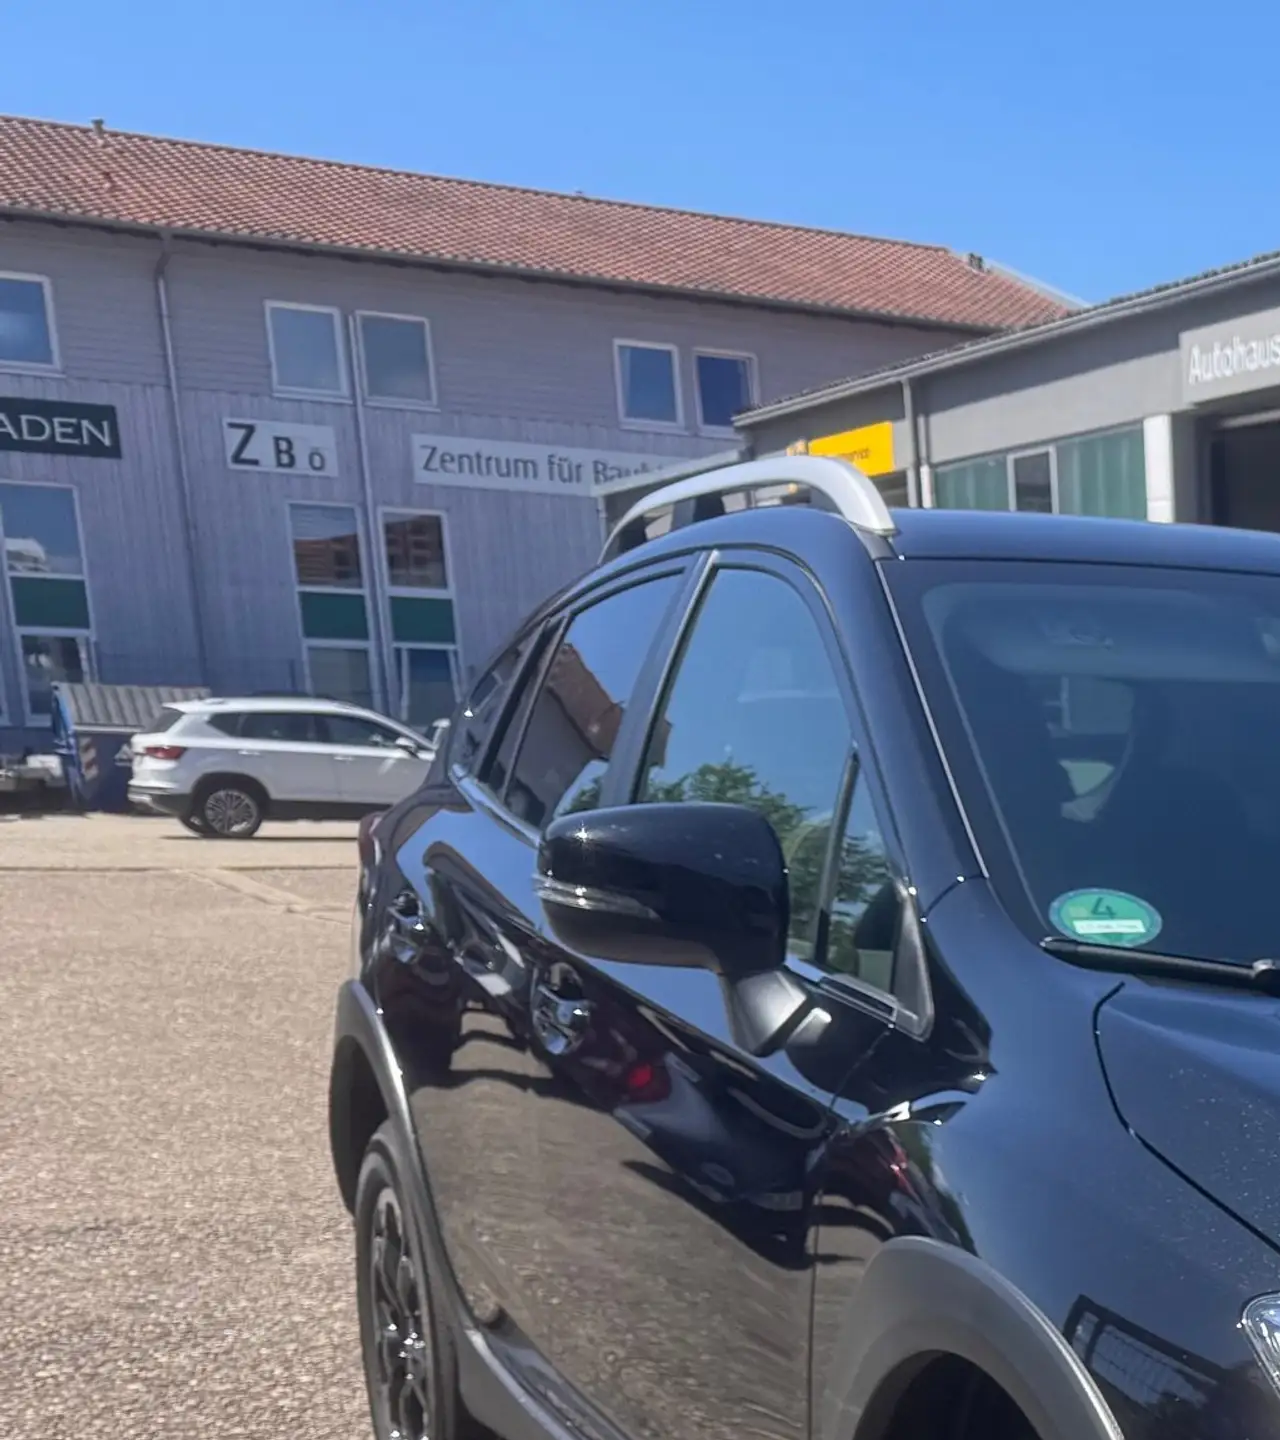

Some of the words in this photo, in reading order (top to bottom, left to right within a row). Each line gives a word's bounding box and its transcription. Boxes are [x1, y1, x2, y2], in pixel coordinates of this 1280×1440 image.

[419, 444, 538, 480] Zentrum
[547, 453, 583, 484] für
[1091, 897, 1117, 919] 4
